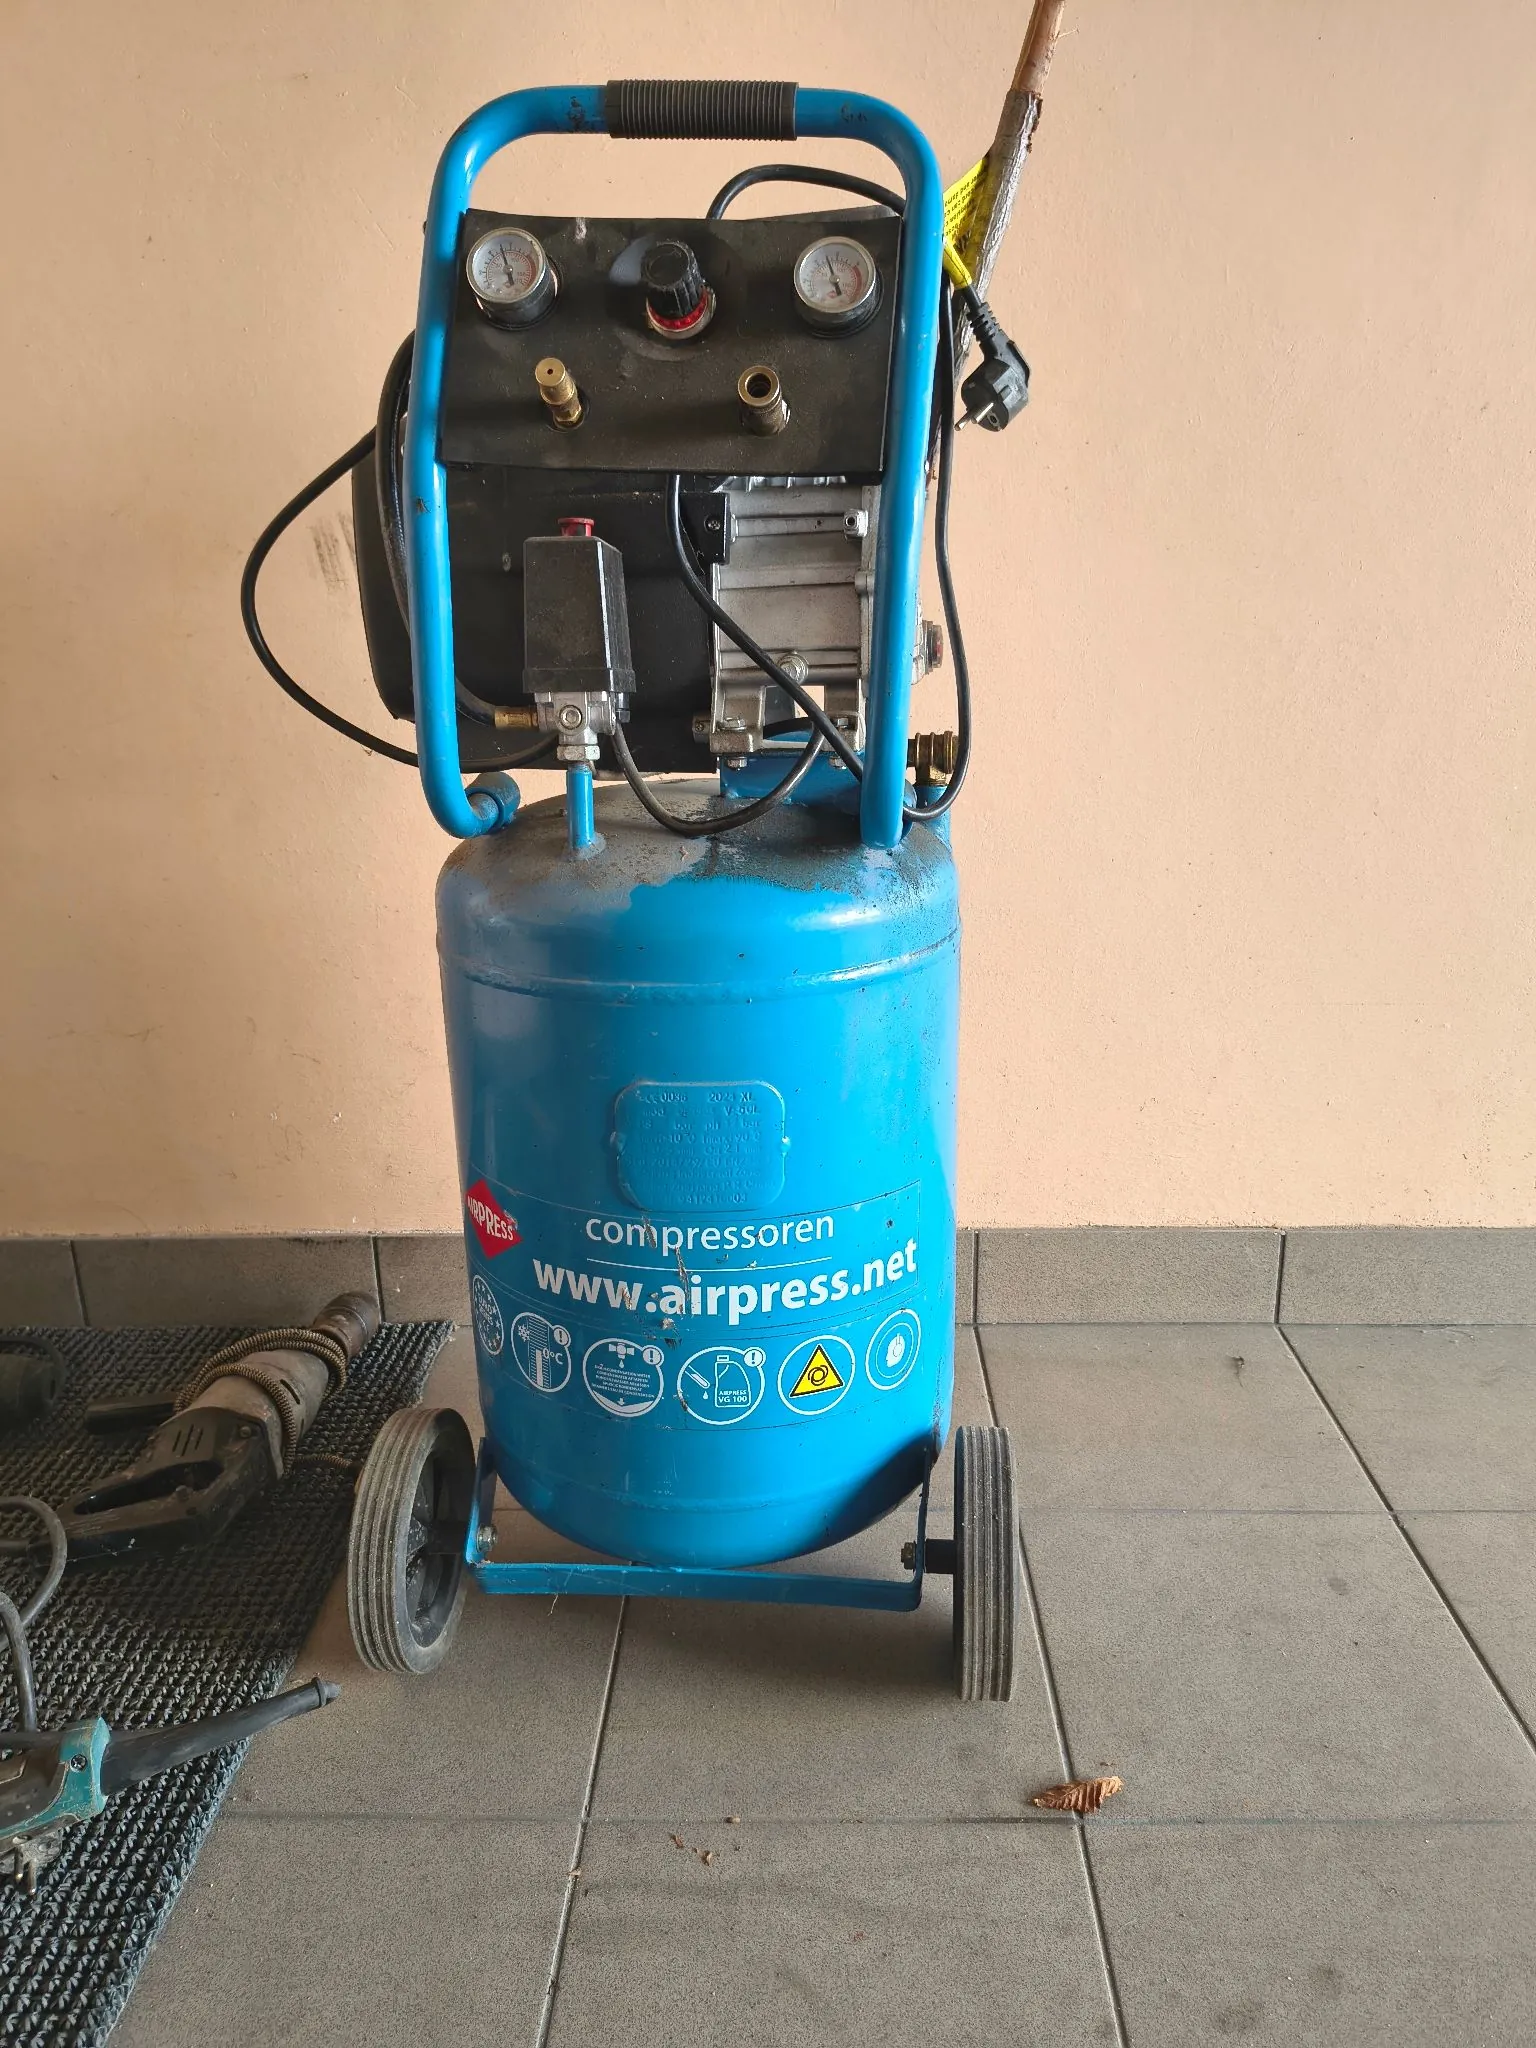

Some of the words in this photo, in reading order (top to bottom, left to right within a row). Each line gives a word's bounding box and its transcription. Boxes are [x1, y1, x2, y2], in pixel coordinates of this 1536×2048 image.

[586, 1215, 834, 1257] compressoren
[532, 1238, 917, 1326] www.airpress.net
[732, 1395, 748, 1403] 100
